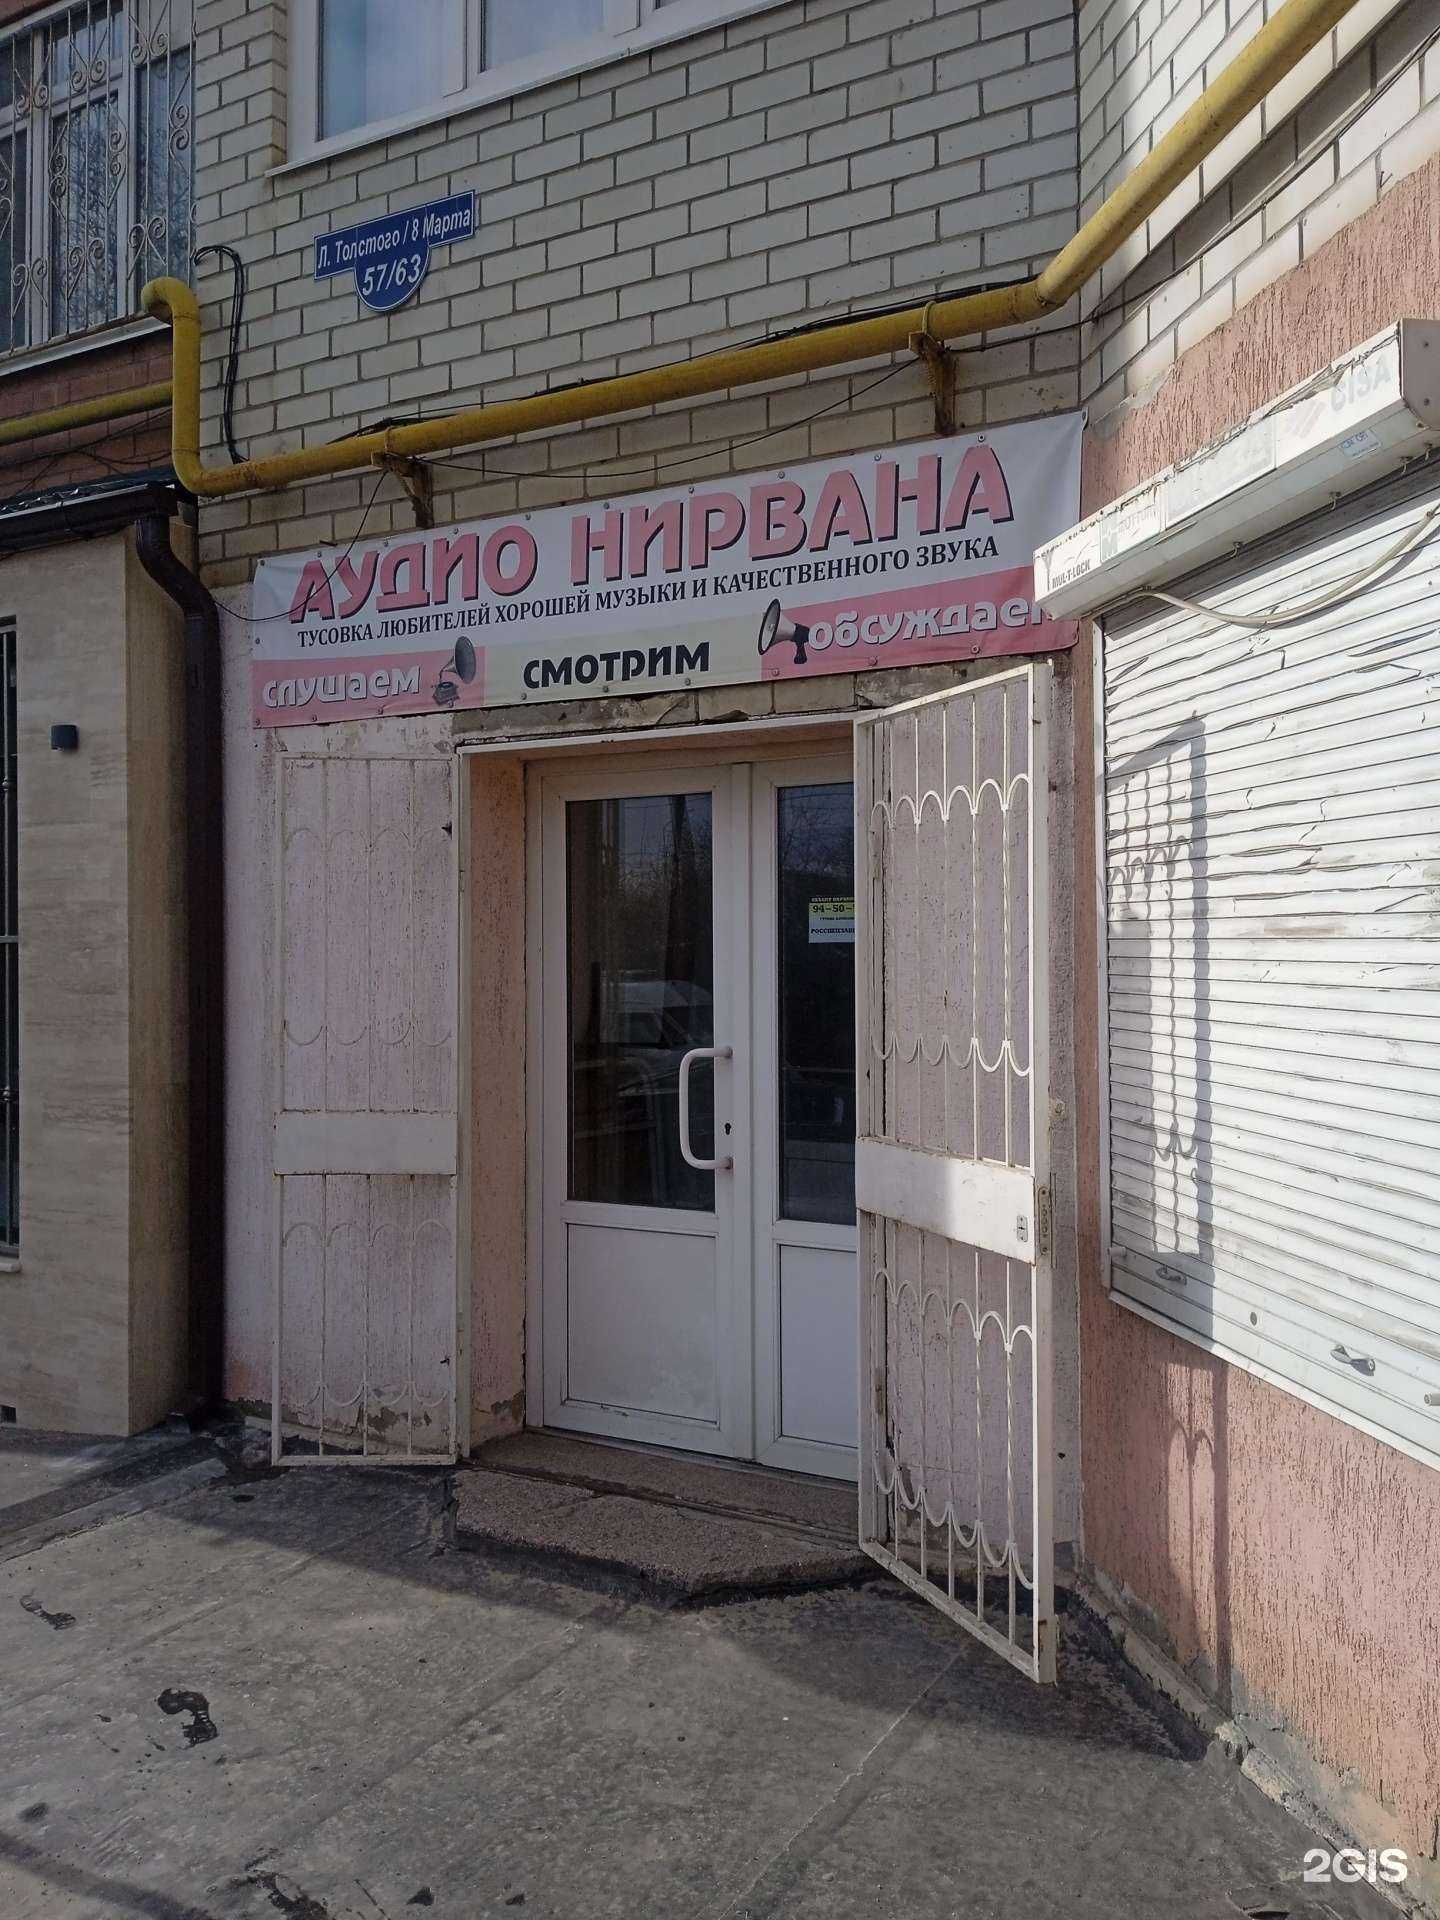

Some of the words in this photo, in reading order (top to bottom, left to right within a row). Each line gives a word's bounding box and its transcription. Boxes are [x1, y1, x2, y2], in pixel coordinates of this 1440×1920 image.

[318, 244, 331, 269] Л.
[335, 229, 400, 263] Толстого
[402, 220, 410, 245] /
[412, 219, 419, 242] 8
[422, 208, 471, 240] Марта
[362, 253, 422, 296] 57/63
[288, 524, 538, 624] АУДИО
[570, 444, 1014, 587] НИРВАНА
[297, 622, 374, 648] ТУСОВКА
[376, 602, 491, 640] ЛЮБИТЕЛЕЙ
[494, 590, 591, 624] ХОРОШЕЙ
[595, 580, 686, 611] МУЗЫКИ
[687, 576, 708, 600] И
[712, 548, 910, 596] КАЧЕСТВЕННОГО
[917, 534, 999, 567] ЗВУКА
[808, 597, 1042, 651] обсуждае
[262, 664, 422, 709] слушаем
[812, 904, 855, 913] 94-50-
